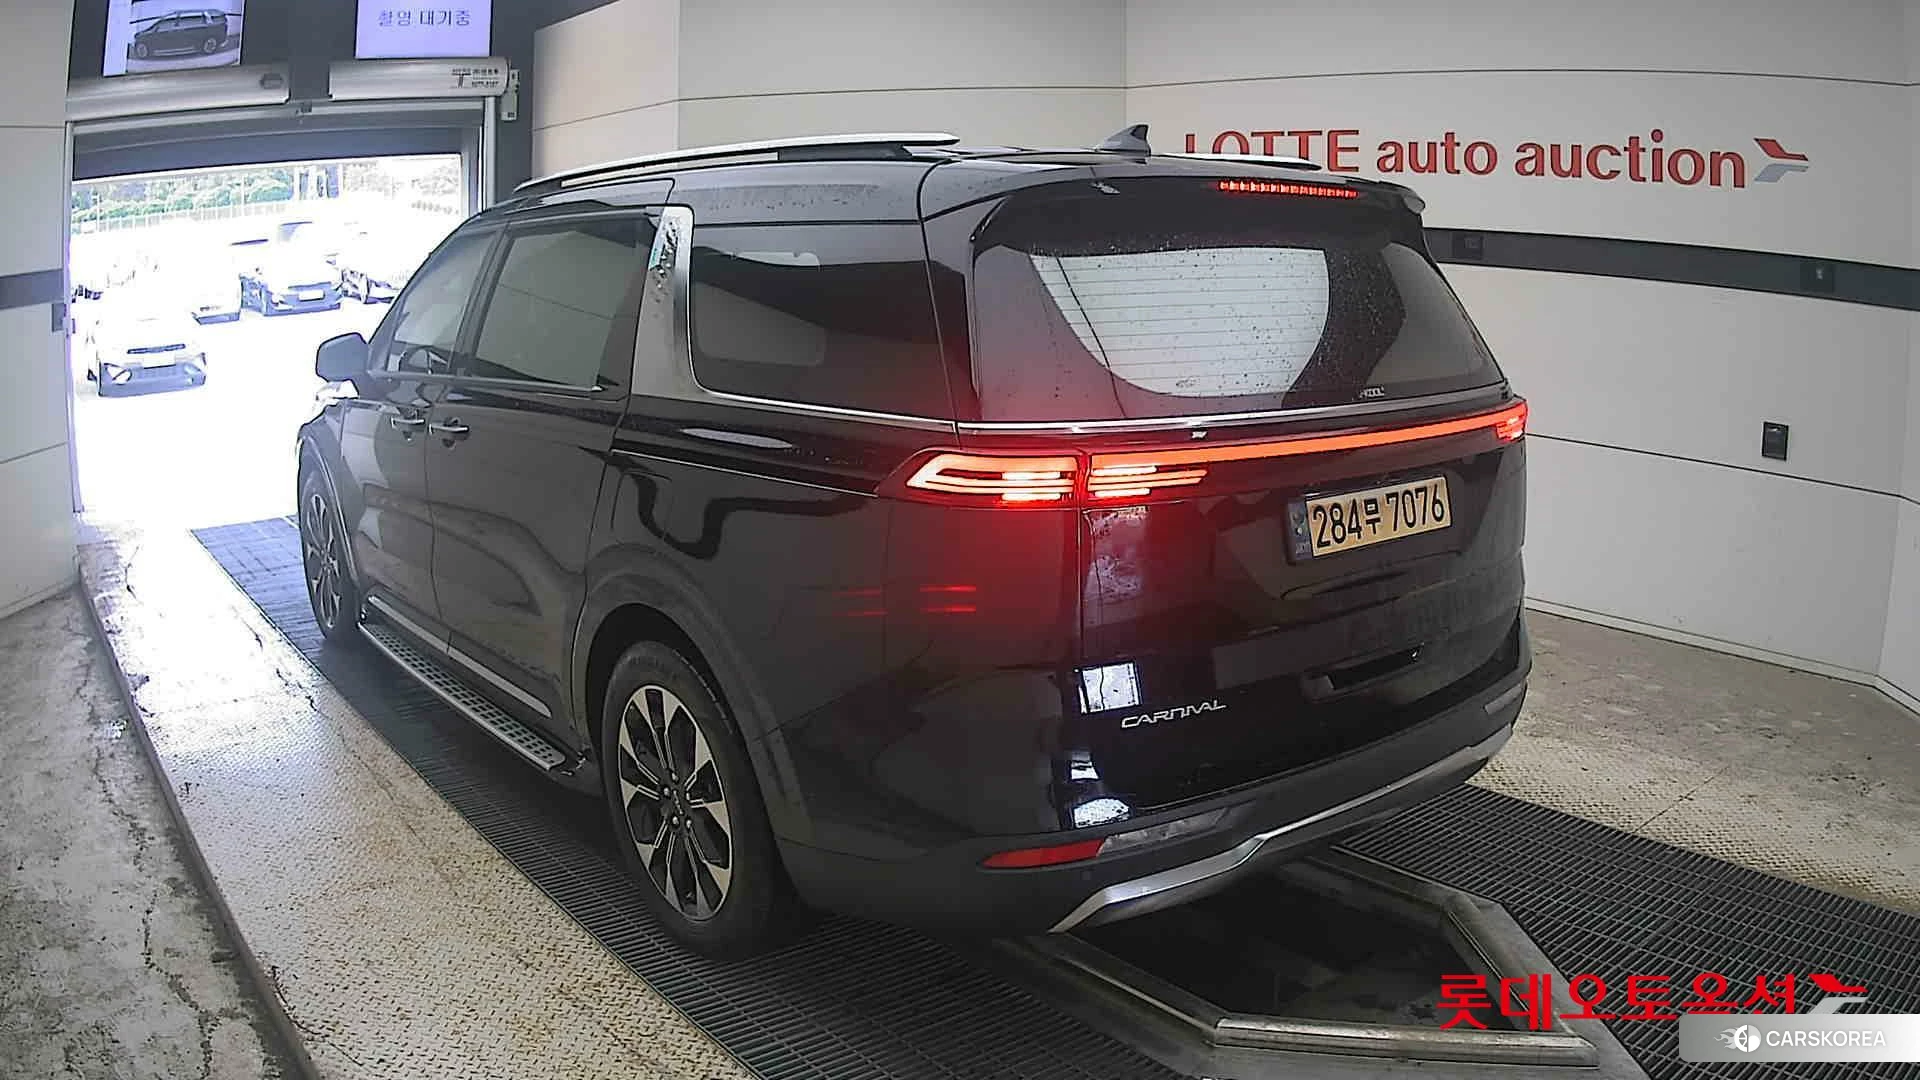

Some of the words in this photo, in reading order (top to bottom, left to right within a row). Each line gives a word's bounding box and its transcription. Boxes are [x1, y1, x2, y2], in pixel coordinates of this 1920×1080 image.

[419, 9, 471, 27] 대기중
[1376, 131, 1498, 176] auto
[1514, 128, 1745, 189] auction
[1385, 484, 1445, 532] 7076
[1121, 699, 1227, 729] CARNIVAL
